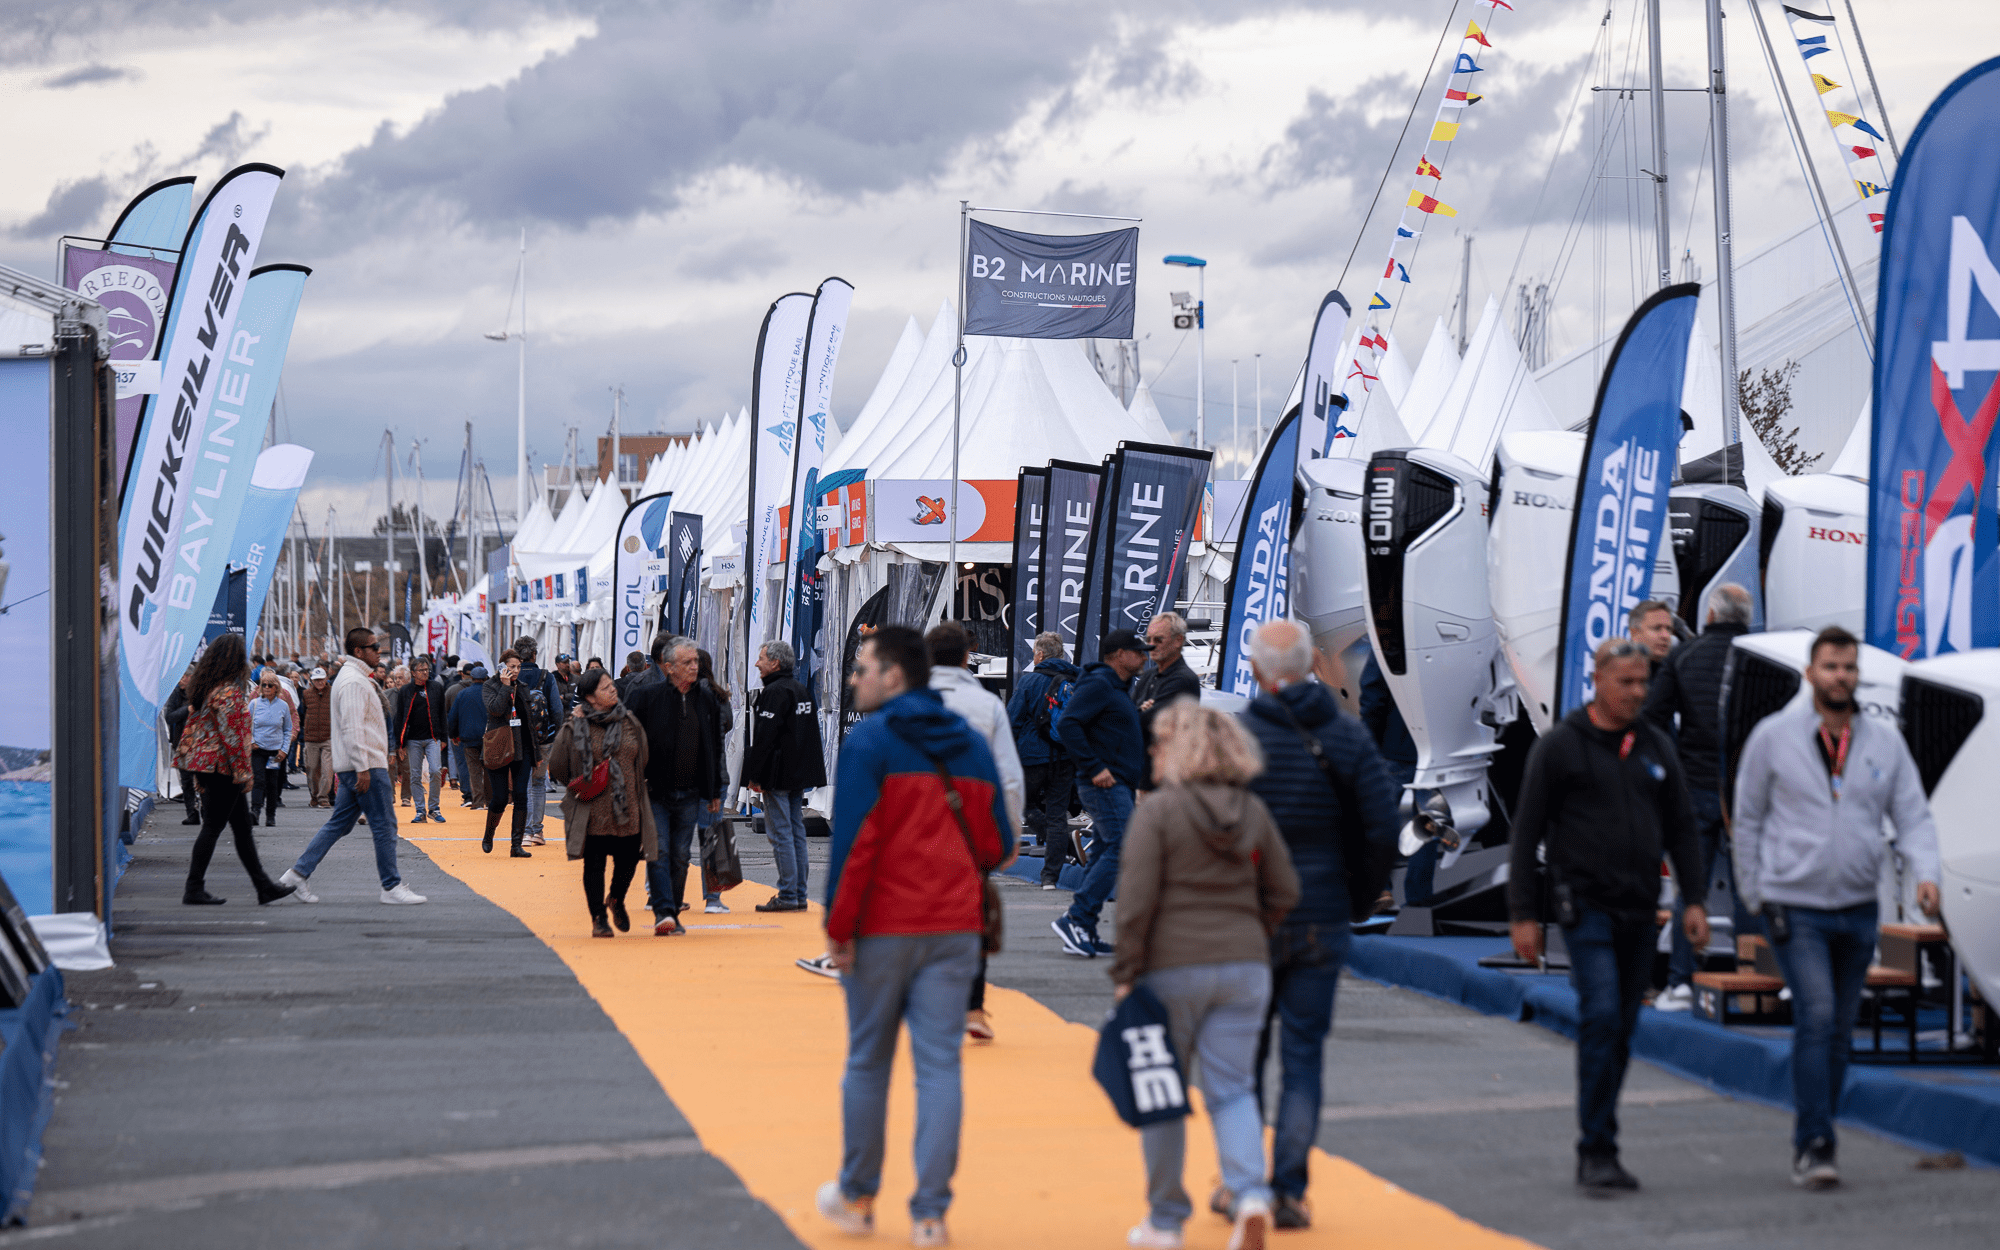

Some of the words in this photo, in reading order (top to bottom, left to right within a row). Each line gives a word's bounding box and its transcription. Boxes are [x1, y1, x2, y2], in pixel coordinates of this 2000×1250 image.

[972, 254, 1006, 281] B2
[83, 271, 165, 320] REEDOM
[1001, 289, 1066, 301] CONSTRUCTIONS
[1067, 294, 1106, 302] NAUTIQUES
[168, 329, 261, 610] BAYLINER
[1369, 477, 1395, 541] 350
[1512, 490, 1574, 511] HON
[721, 562, 736, 570] H36
[623, 575, 642, 647] april
